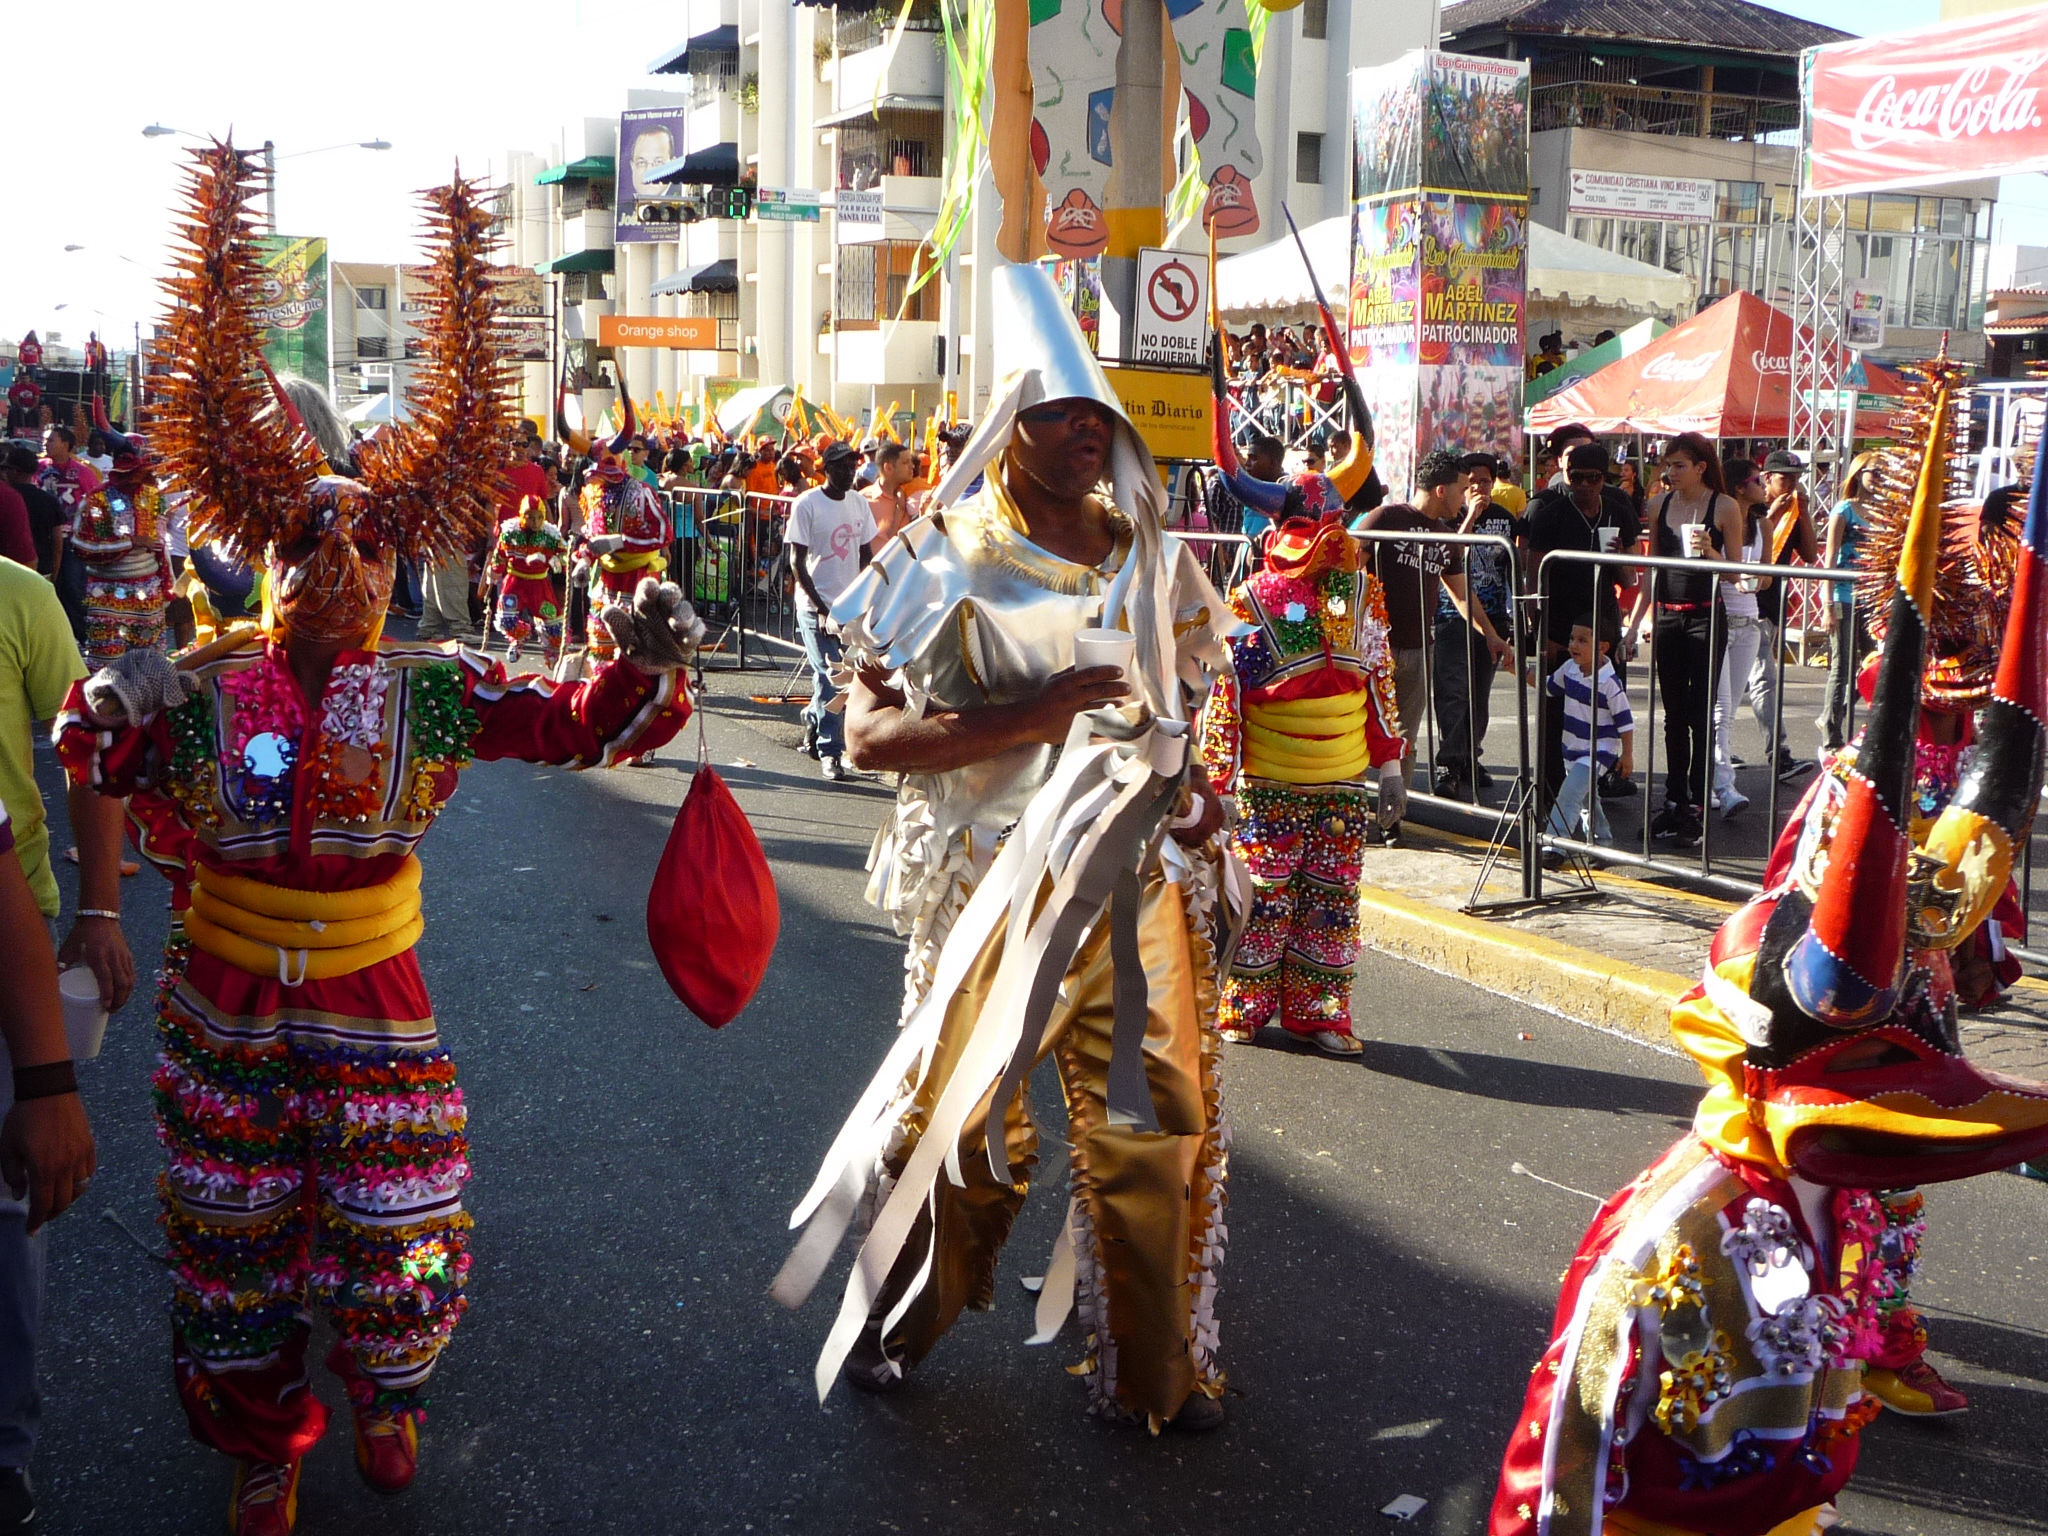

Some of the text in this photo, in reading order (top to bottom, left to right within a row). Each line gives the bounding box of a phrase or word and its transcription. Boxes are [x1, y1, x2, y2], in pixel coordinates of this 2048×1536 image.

[1436, 55, 1453, 67] Los
[1585, 173, 1624, 187] COMUNIDAD
[1625, 177, 1658, 189] CRISTIANA
[1660, 180, 1675, 191] VINO
[1676, 182, 1696, 193] NUEVO
[838, 213, 860, 222] SANTA
[840, 205, 880, 213] FARMACIA
[1368, 287, 1392, 306] ABEL
[1446, 284, 1482, 302] ABEL
[1353, 300, 1415, 327] MARTINEZ
[1425, 292, 1518, 323] MARTINEZ
[618, 323, 698, 340] Orange shop
[1351, 324, 1415, 348] PATROCINADOR
[1422, 324, 1518, 345] PATROCINADOR
[1141, 333, 1197, 350] NO DOBLE
[1140, 349, 1197, 364] IZQUIERDA
[1151, 400, 1203, 419] Diario
